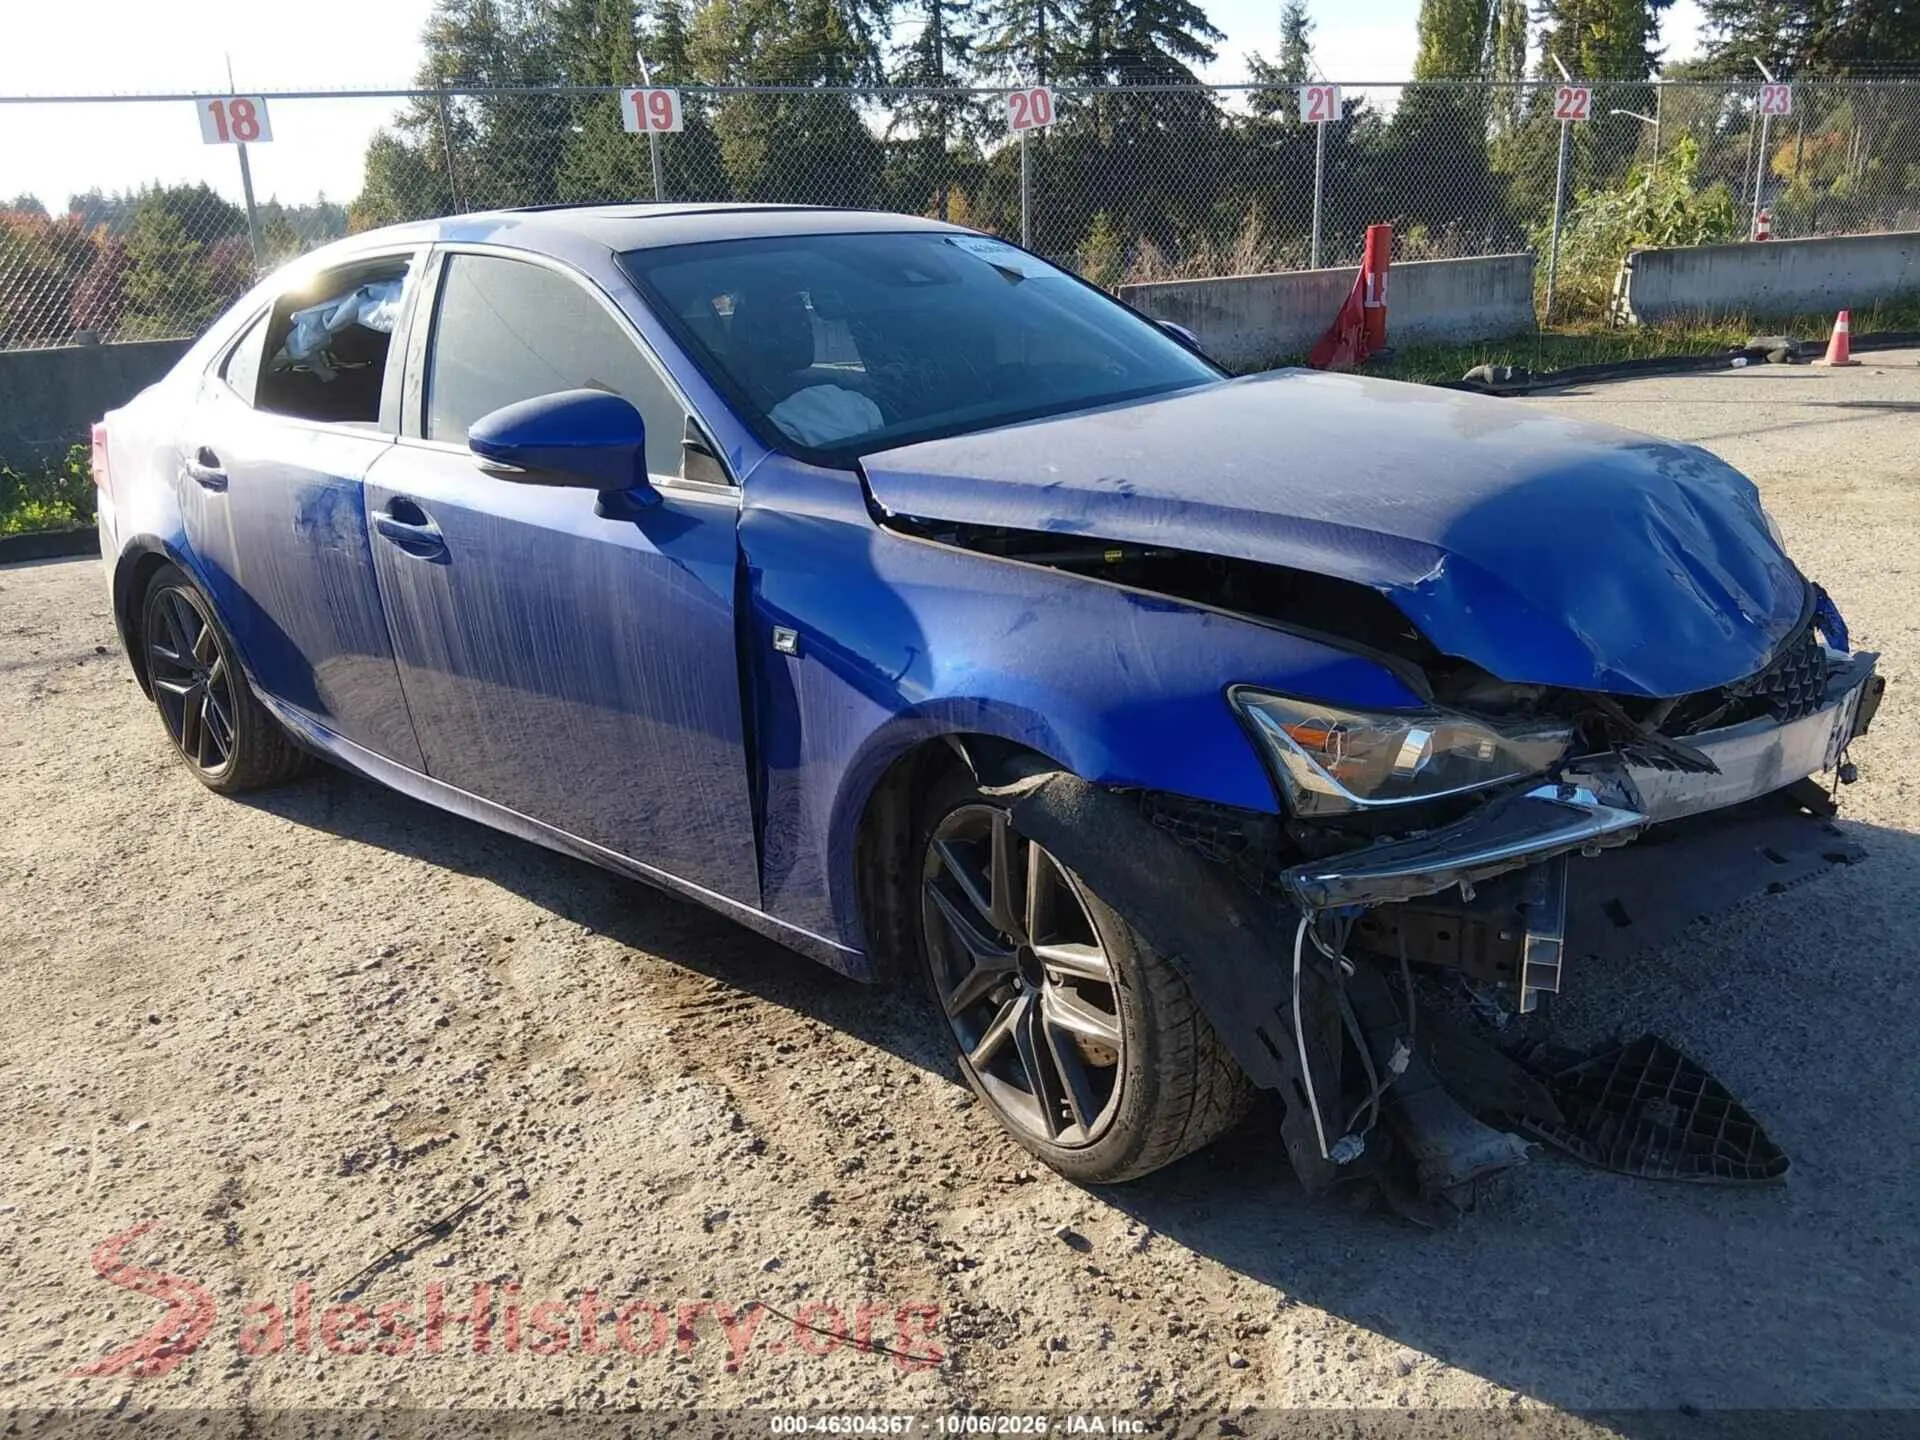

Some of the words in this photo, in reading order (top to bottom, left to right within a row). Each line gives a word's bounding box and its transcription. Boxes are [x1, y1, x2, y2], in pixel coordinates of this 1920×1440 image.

[631, 91, 673, 130] 19
[1009, 88, 1051, 129] 20
[1307, 87, 1335, 121] 21
[1556, 88, 1588, 118] 22
[1762, 84, 1789, 114] 23
[208, 98, 260, 142] 18
